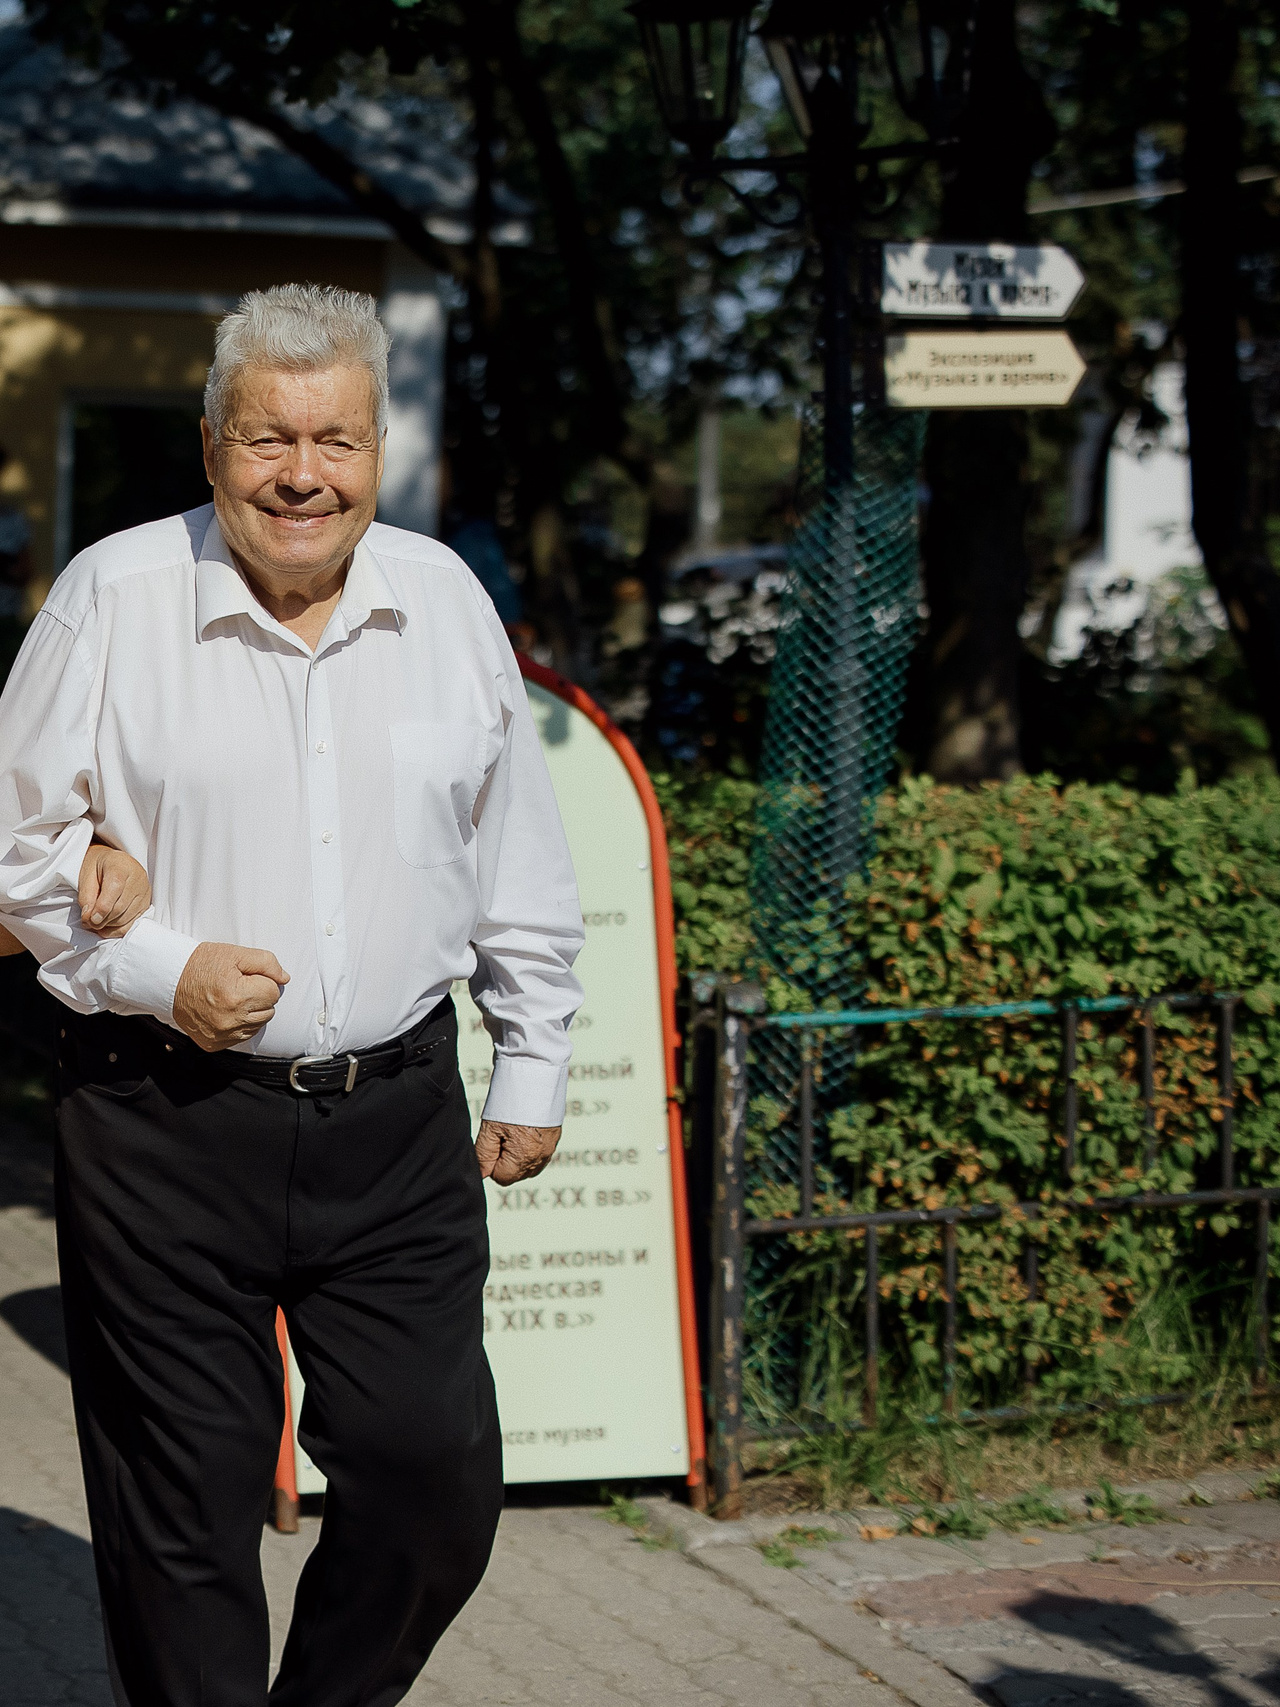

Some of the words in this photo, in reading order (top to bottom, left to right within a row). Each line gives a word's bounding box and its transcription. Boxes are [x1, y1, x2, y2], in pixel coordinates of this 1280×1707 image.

[929, 351, 1035, 367] Экспозиция
[984, 373, 994, 385] и
[1000, 372, 1068, 389] время»
[497, 1187, 586, 1211] XIX-XX
[540, 1249, 625, 1269] иконы
[633, 1248, 648, 1265] и
[501, 1308, 546, 1331] XIX
